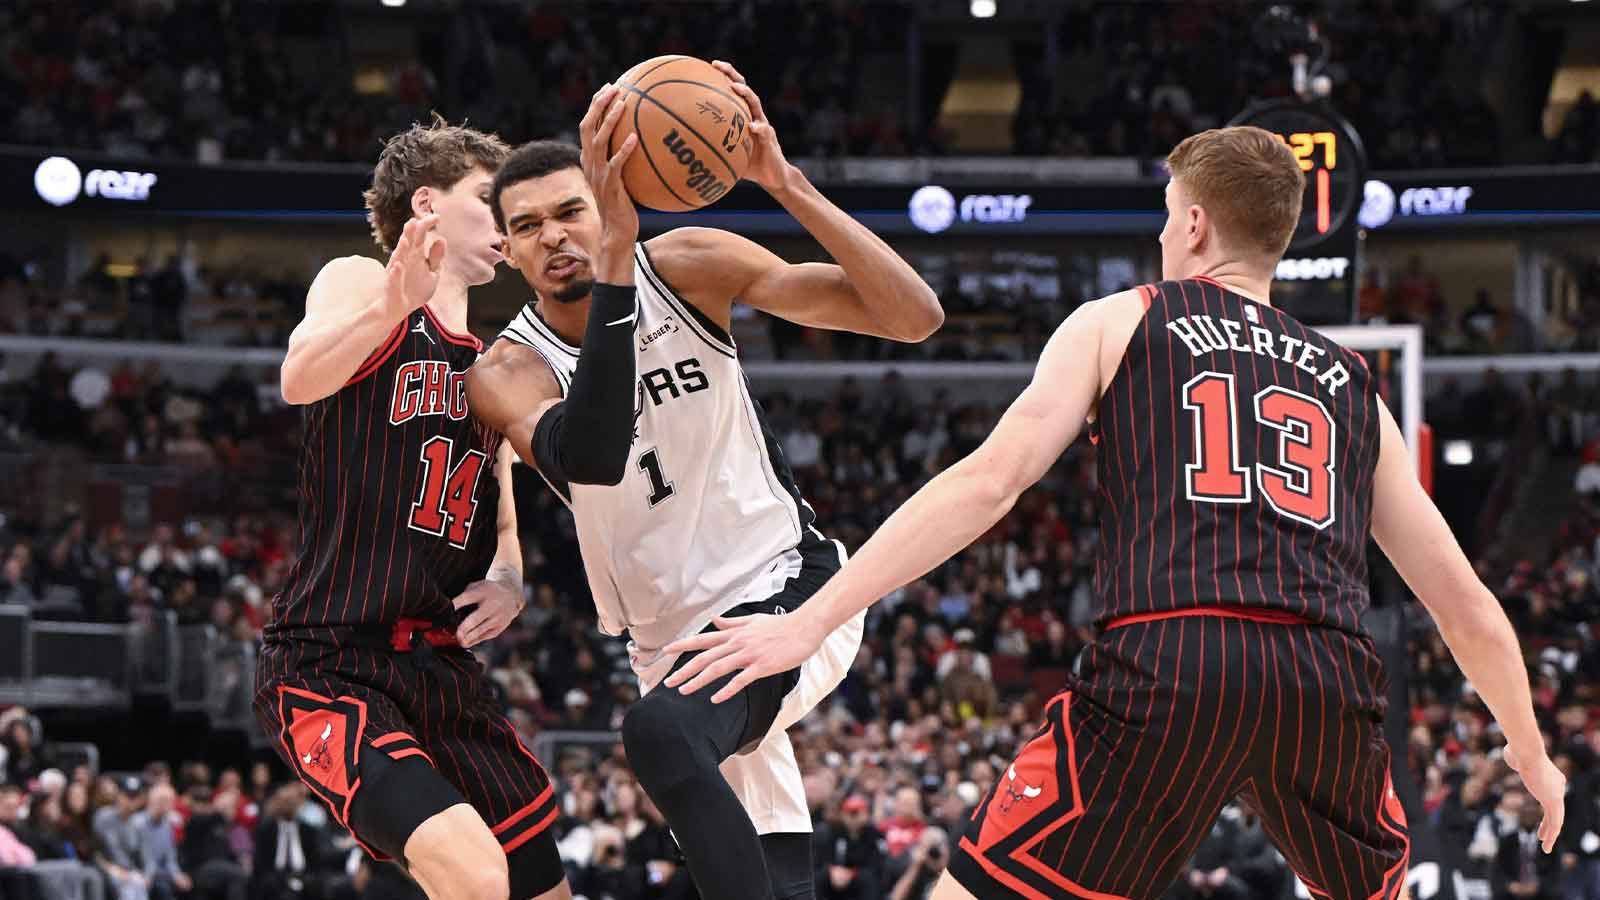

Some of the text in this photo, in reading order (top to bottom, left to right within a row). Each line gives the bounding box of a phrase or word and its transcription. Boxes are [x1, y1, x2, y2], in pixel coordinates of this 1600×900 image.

[662, 127, 727, 200] Wilson
[1274, 132, 1336, 171] 27
[641, 323, 671, 345] LEDGER
[1166, 315, 1350, 396] HUERTER
[640, 358, 709, 406] RS
[636, 446, 676, 510] 1
[1182, 371, 1335, 530] 13
[407, 435, 487, 550] 14
